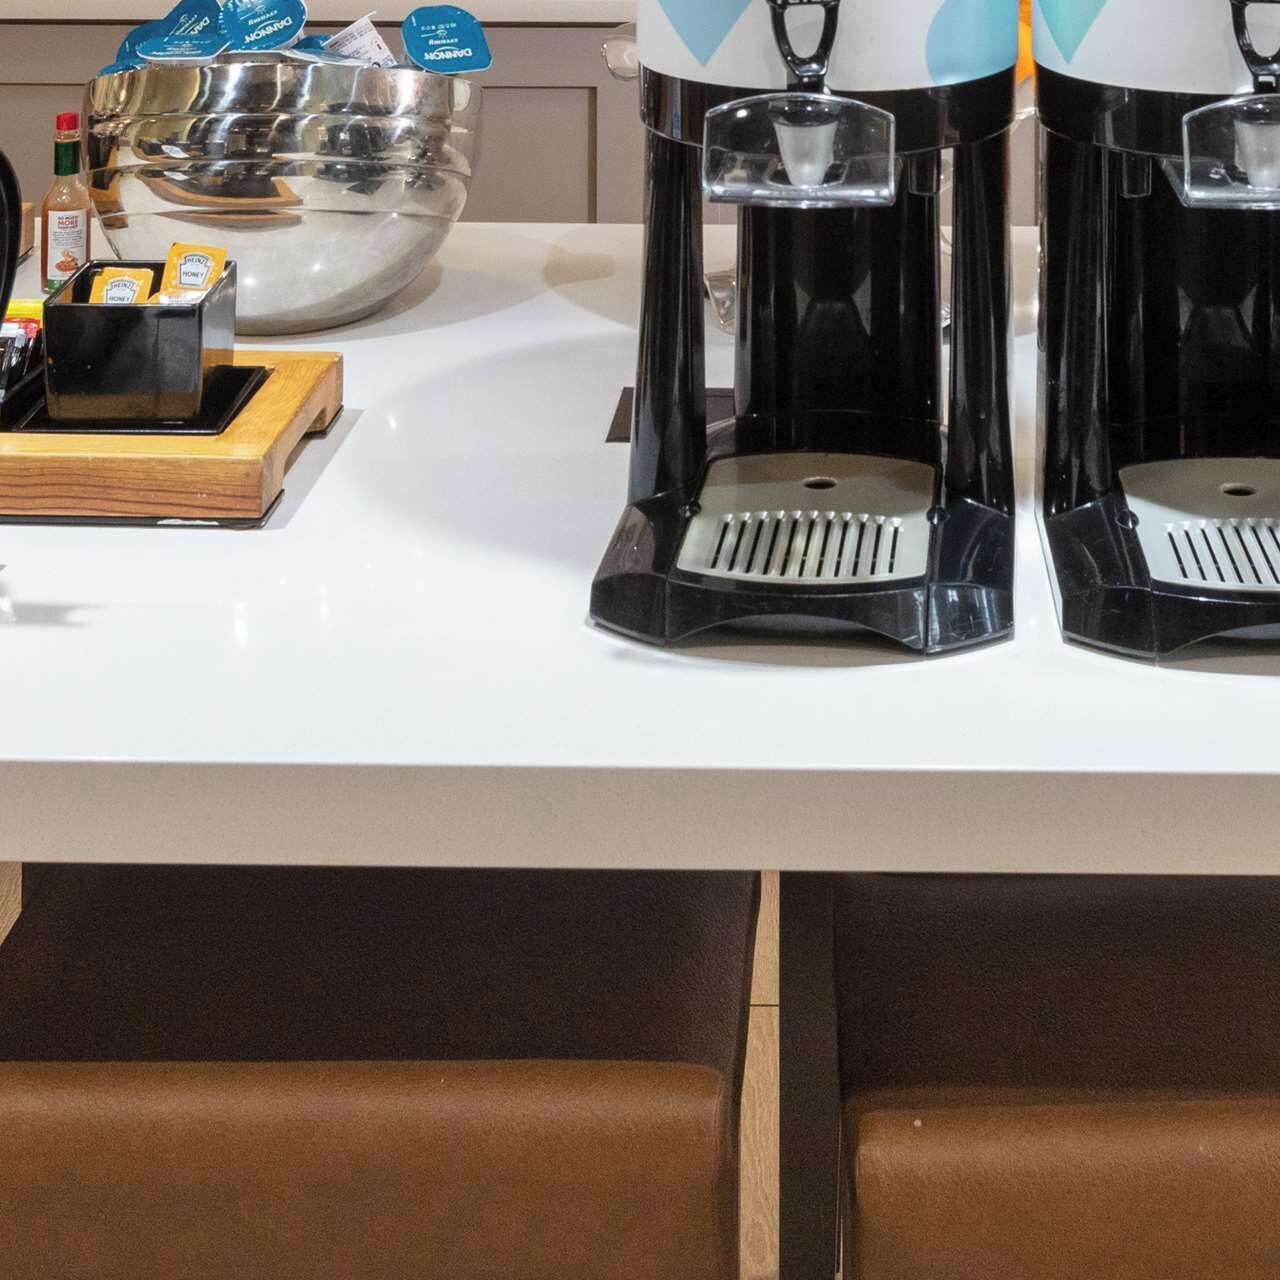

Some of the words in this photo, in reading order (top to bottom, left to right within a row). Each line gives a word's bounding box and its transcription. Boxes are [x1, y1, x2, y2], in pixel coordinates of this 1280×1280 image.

[244, 15, 293, 43] DANNON
[423, 47, 473, 61] DANNON
[185, 256, 207, 264] HEINZ
